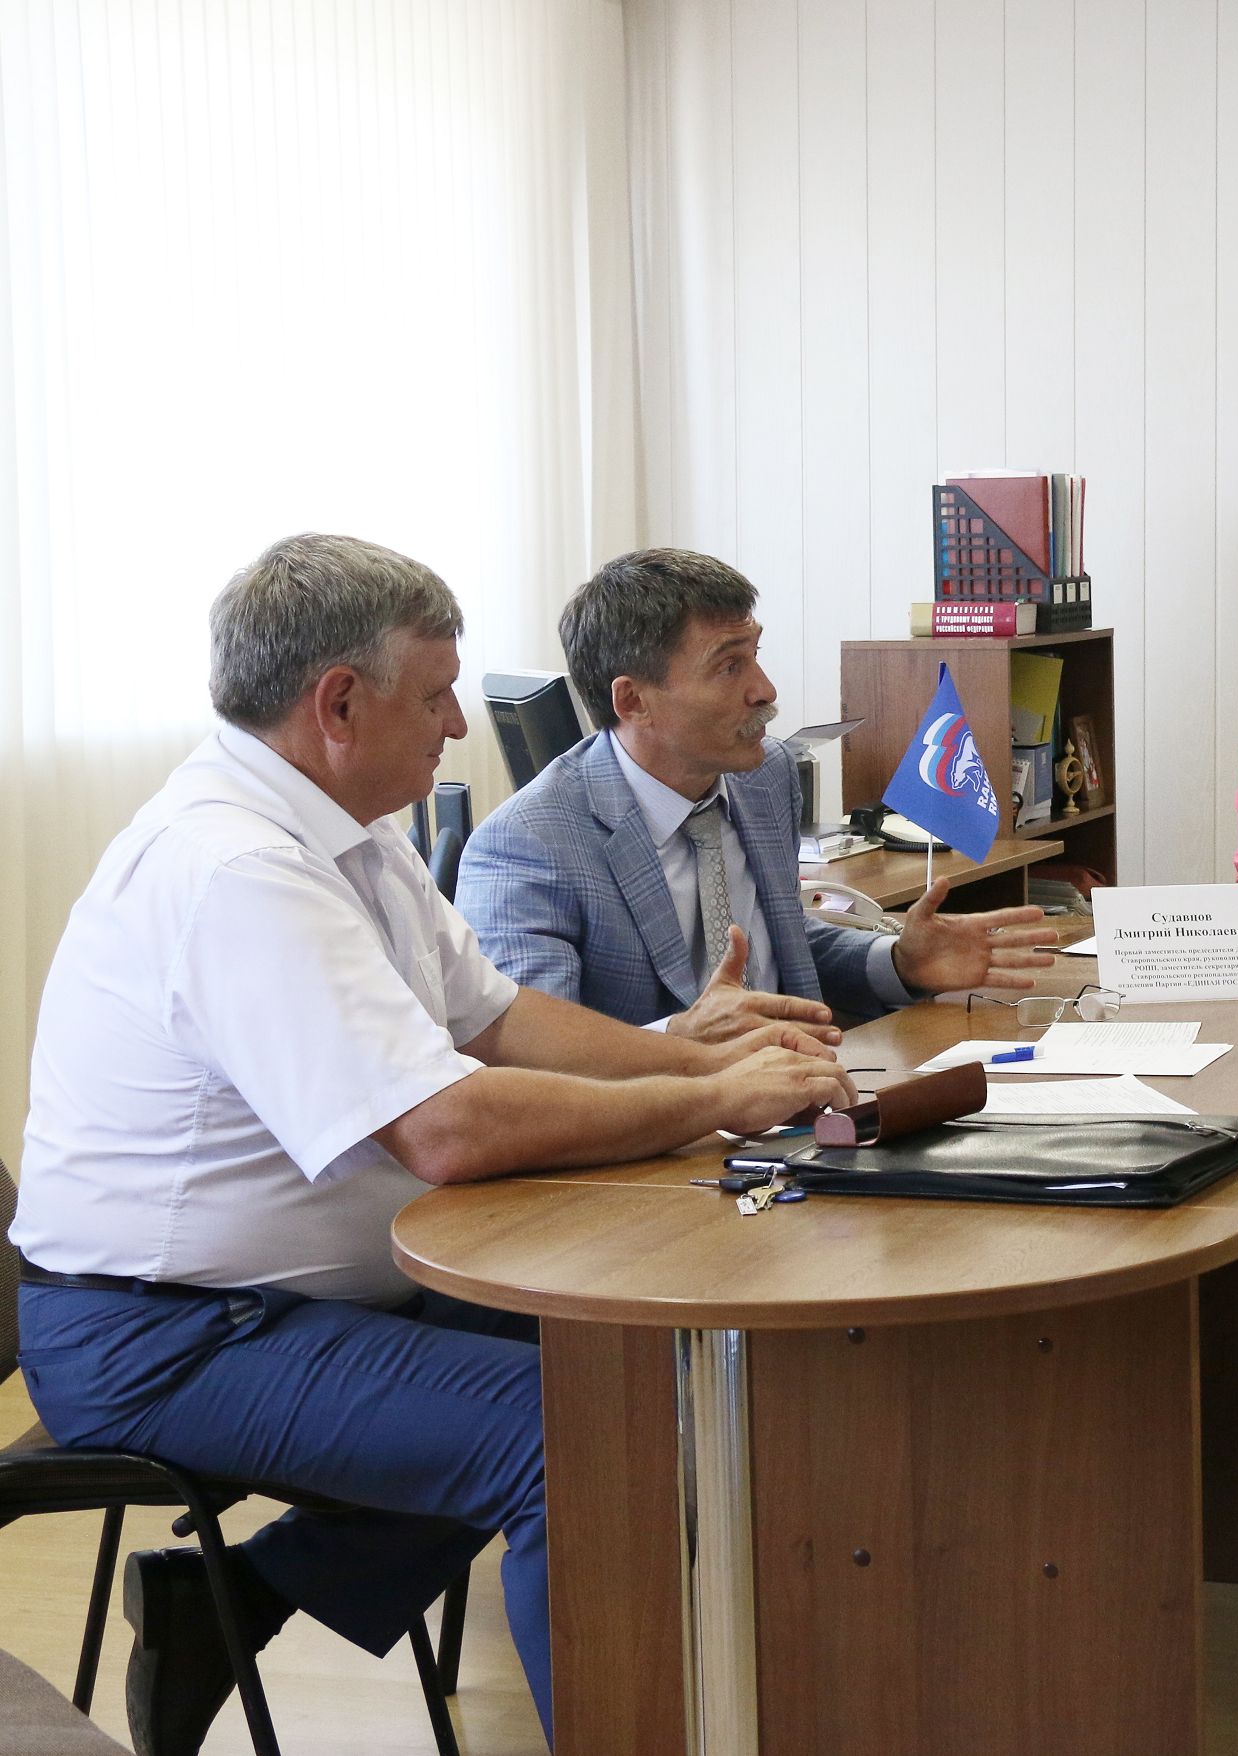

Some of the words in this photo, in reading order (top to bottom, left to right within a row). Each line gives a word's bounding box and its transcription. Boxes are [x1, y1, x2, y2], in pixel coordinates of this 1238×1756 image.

[1151, 912, 1213, 925] Судавцов
[1113, 928, 1171, 941] Дмитрий
[1114, 949, 1143, 957] Первый
[1120, 957, 1182, 965] Ставропольского
[1130, 973, 1192, 981] Ставропольского
[1155, 980, 1182, 989] Партии
